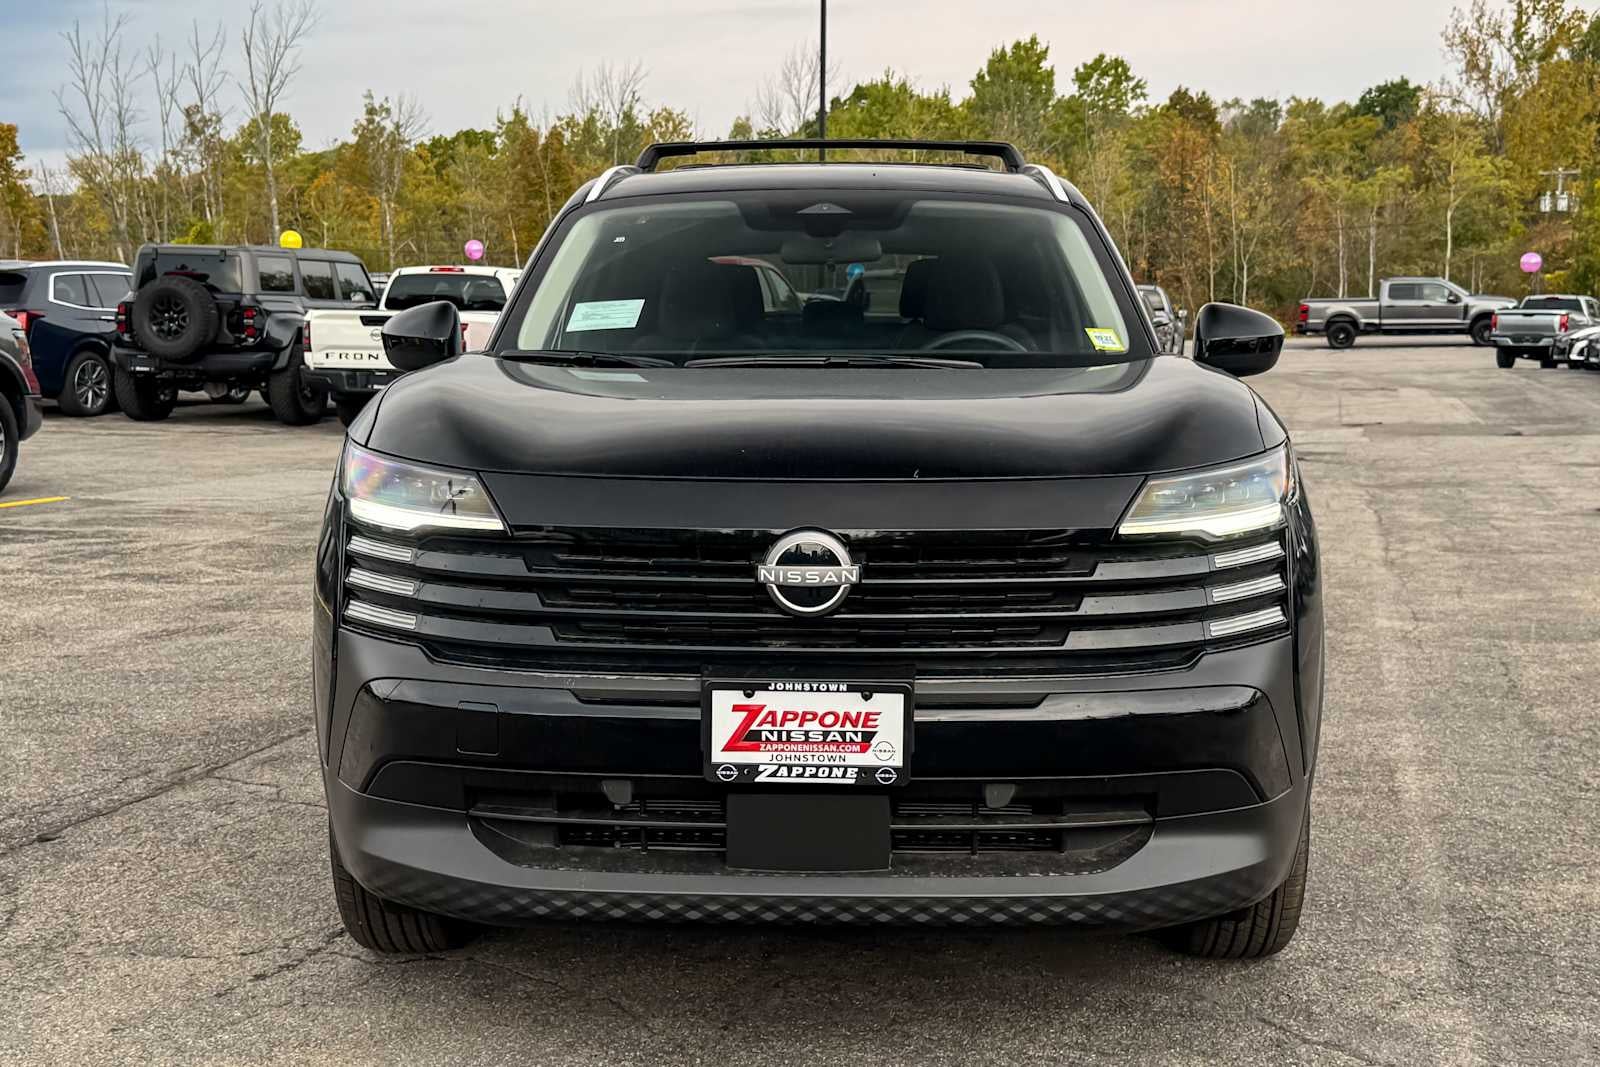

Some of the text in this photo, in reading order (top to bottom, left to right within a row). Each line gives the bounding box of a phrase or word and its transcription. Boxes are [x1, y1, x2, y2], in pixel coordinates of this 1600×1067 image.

[325, 352, 379, 360] FRON
[760, 568, 857, 583] NISSAN
[768, 682, 848, 692] JOHNSTOWN
[721, 704, 882, 752] ZAPPONE
[761, 730, 862, 742] NISSAN
[759, 743, 861, 753] ZAPPONENISSAN.COM
[769, 754, 847, 763] JOHNSTOWN
[754, 764, 859, 784] ZAPPONE
